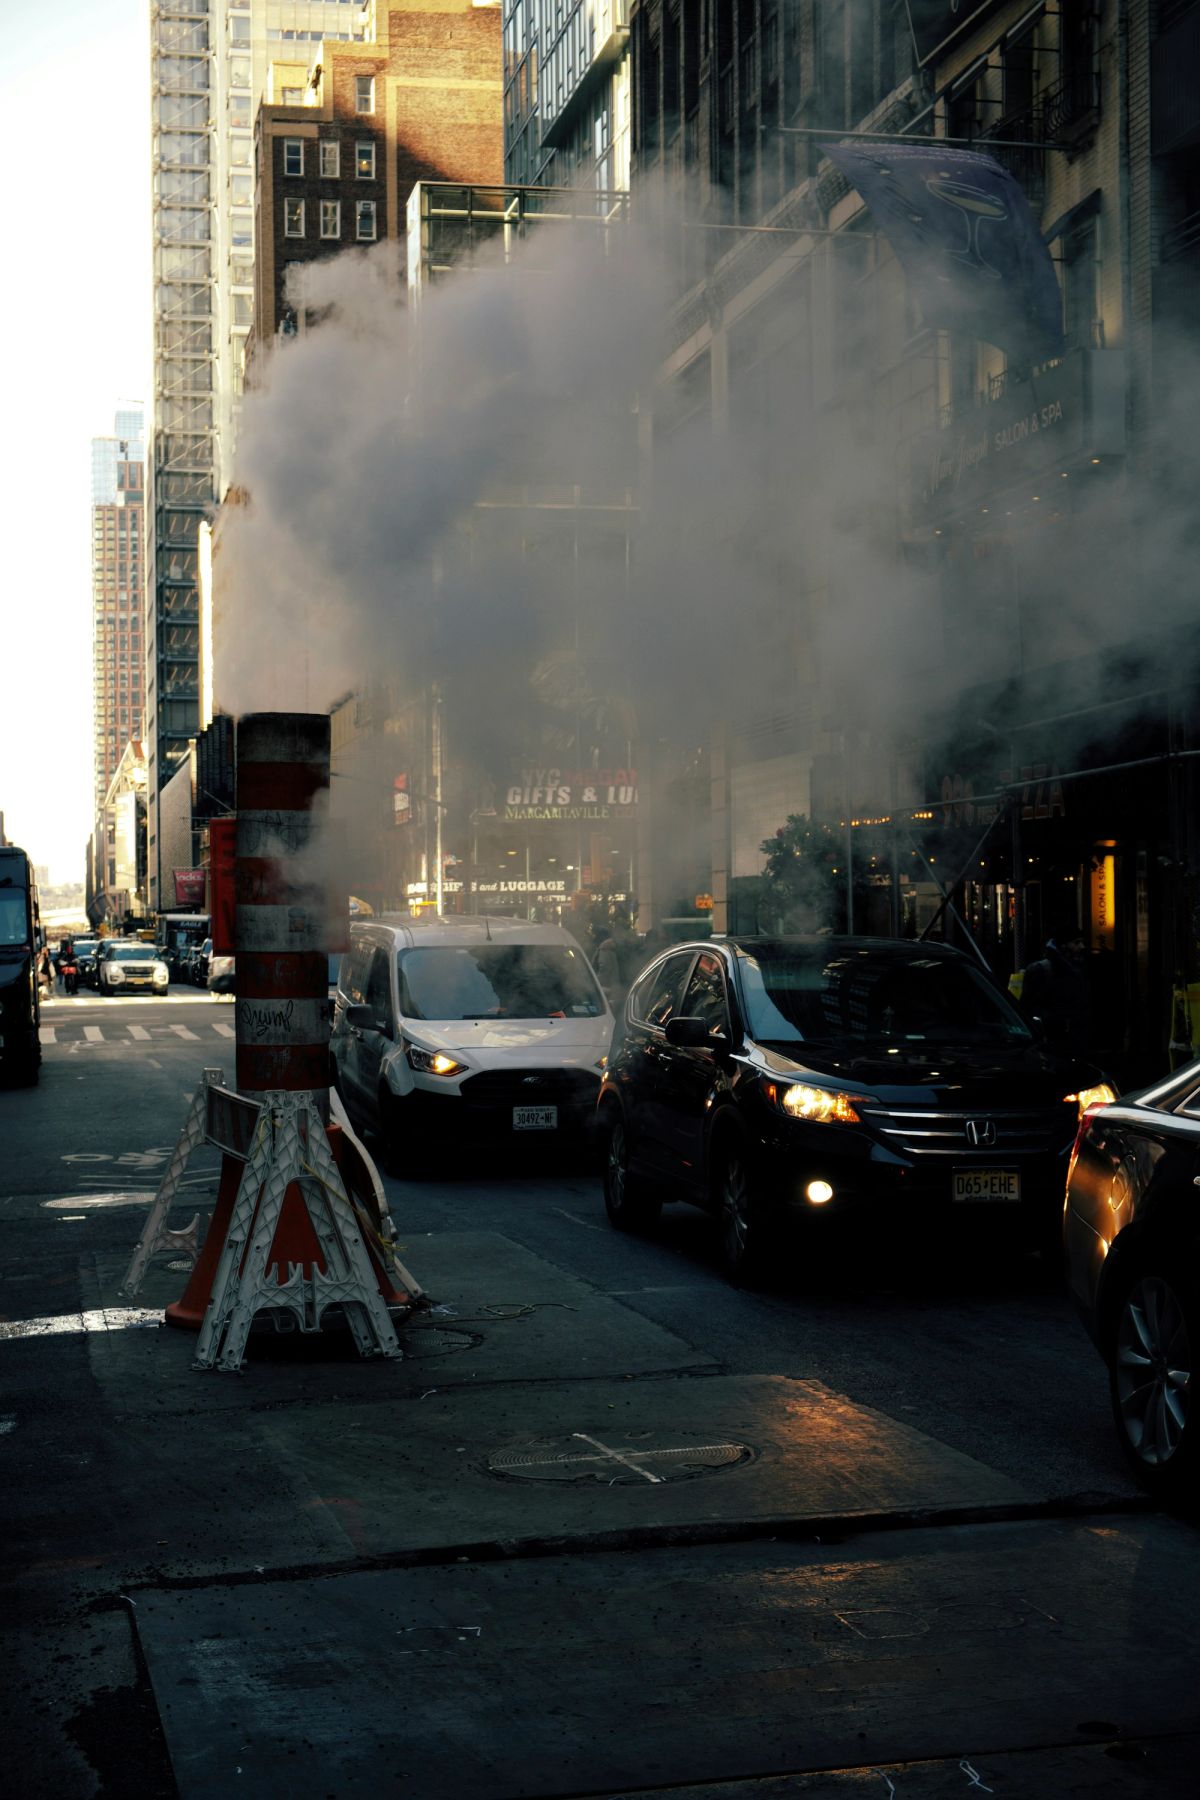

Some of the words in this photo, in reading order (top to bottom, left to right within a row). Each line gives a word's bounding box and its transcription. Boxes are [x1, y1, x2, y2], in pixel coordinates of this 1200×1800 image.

[995, 417, 1029, 451] SALON
[1032, 413, 1039, 432] &
[1042, 401, 1063, 428] SPA
[507, 786, 571, 805] GIFTS
[582, 787, 598, 802] &
[479, 881, 498, 892] and
[500, 881, 565, 892] LUGGAGE
